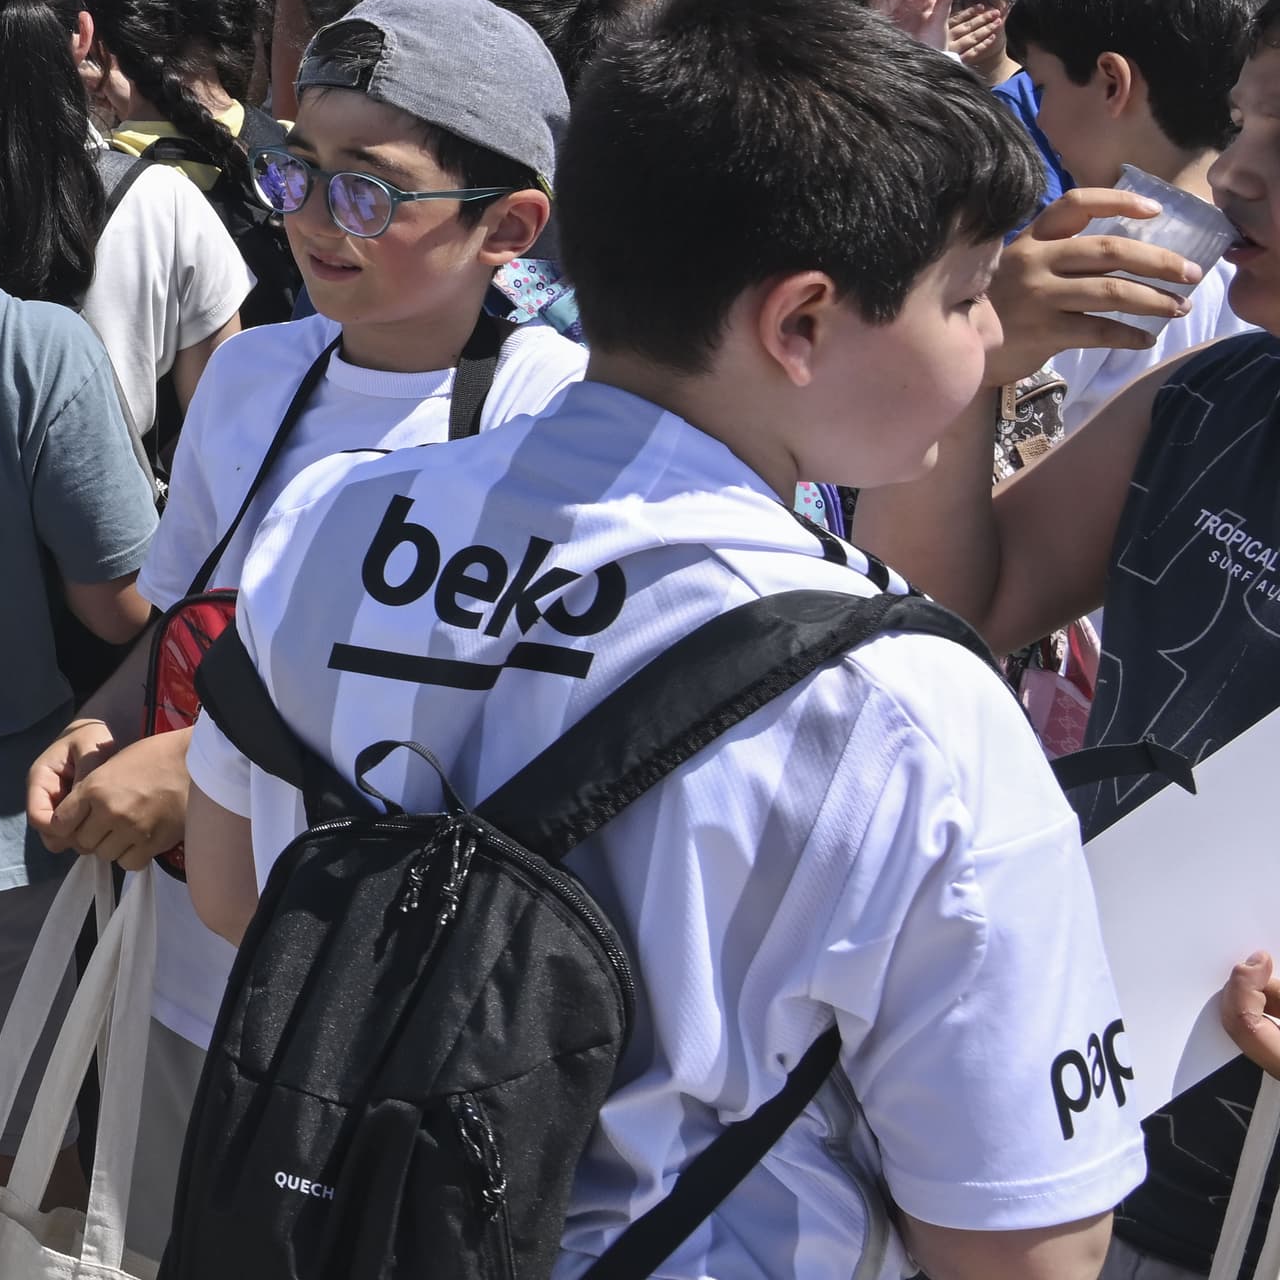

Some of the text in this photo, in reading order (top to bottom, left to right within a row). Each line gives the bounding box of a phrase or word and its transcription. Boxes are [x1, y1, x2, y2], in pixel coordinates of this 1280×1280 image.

[1194, 508, 1279, 572] TROPICAL
[362, 494, 627, 637] beko
[1208, 550, 1254, 581] SURF
[274, 1171, 335, 1200] QUECH
